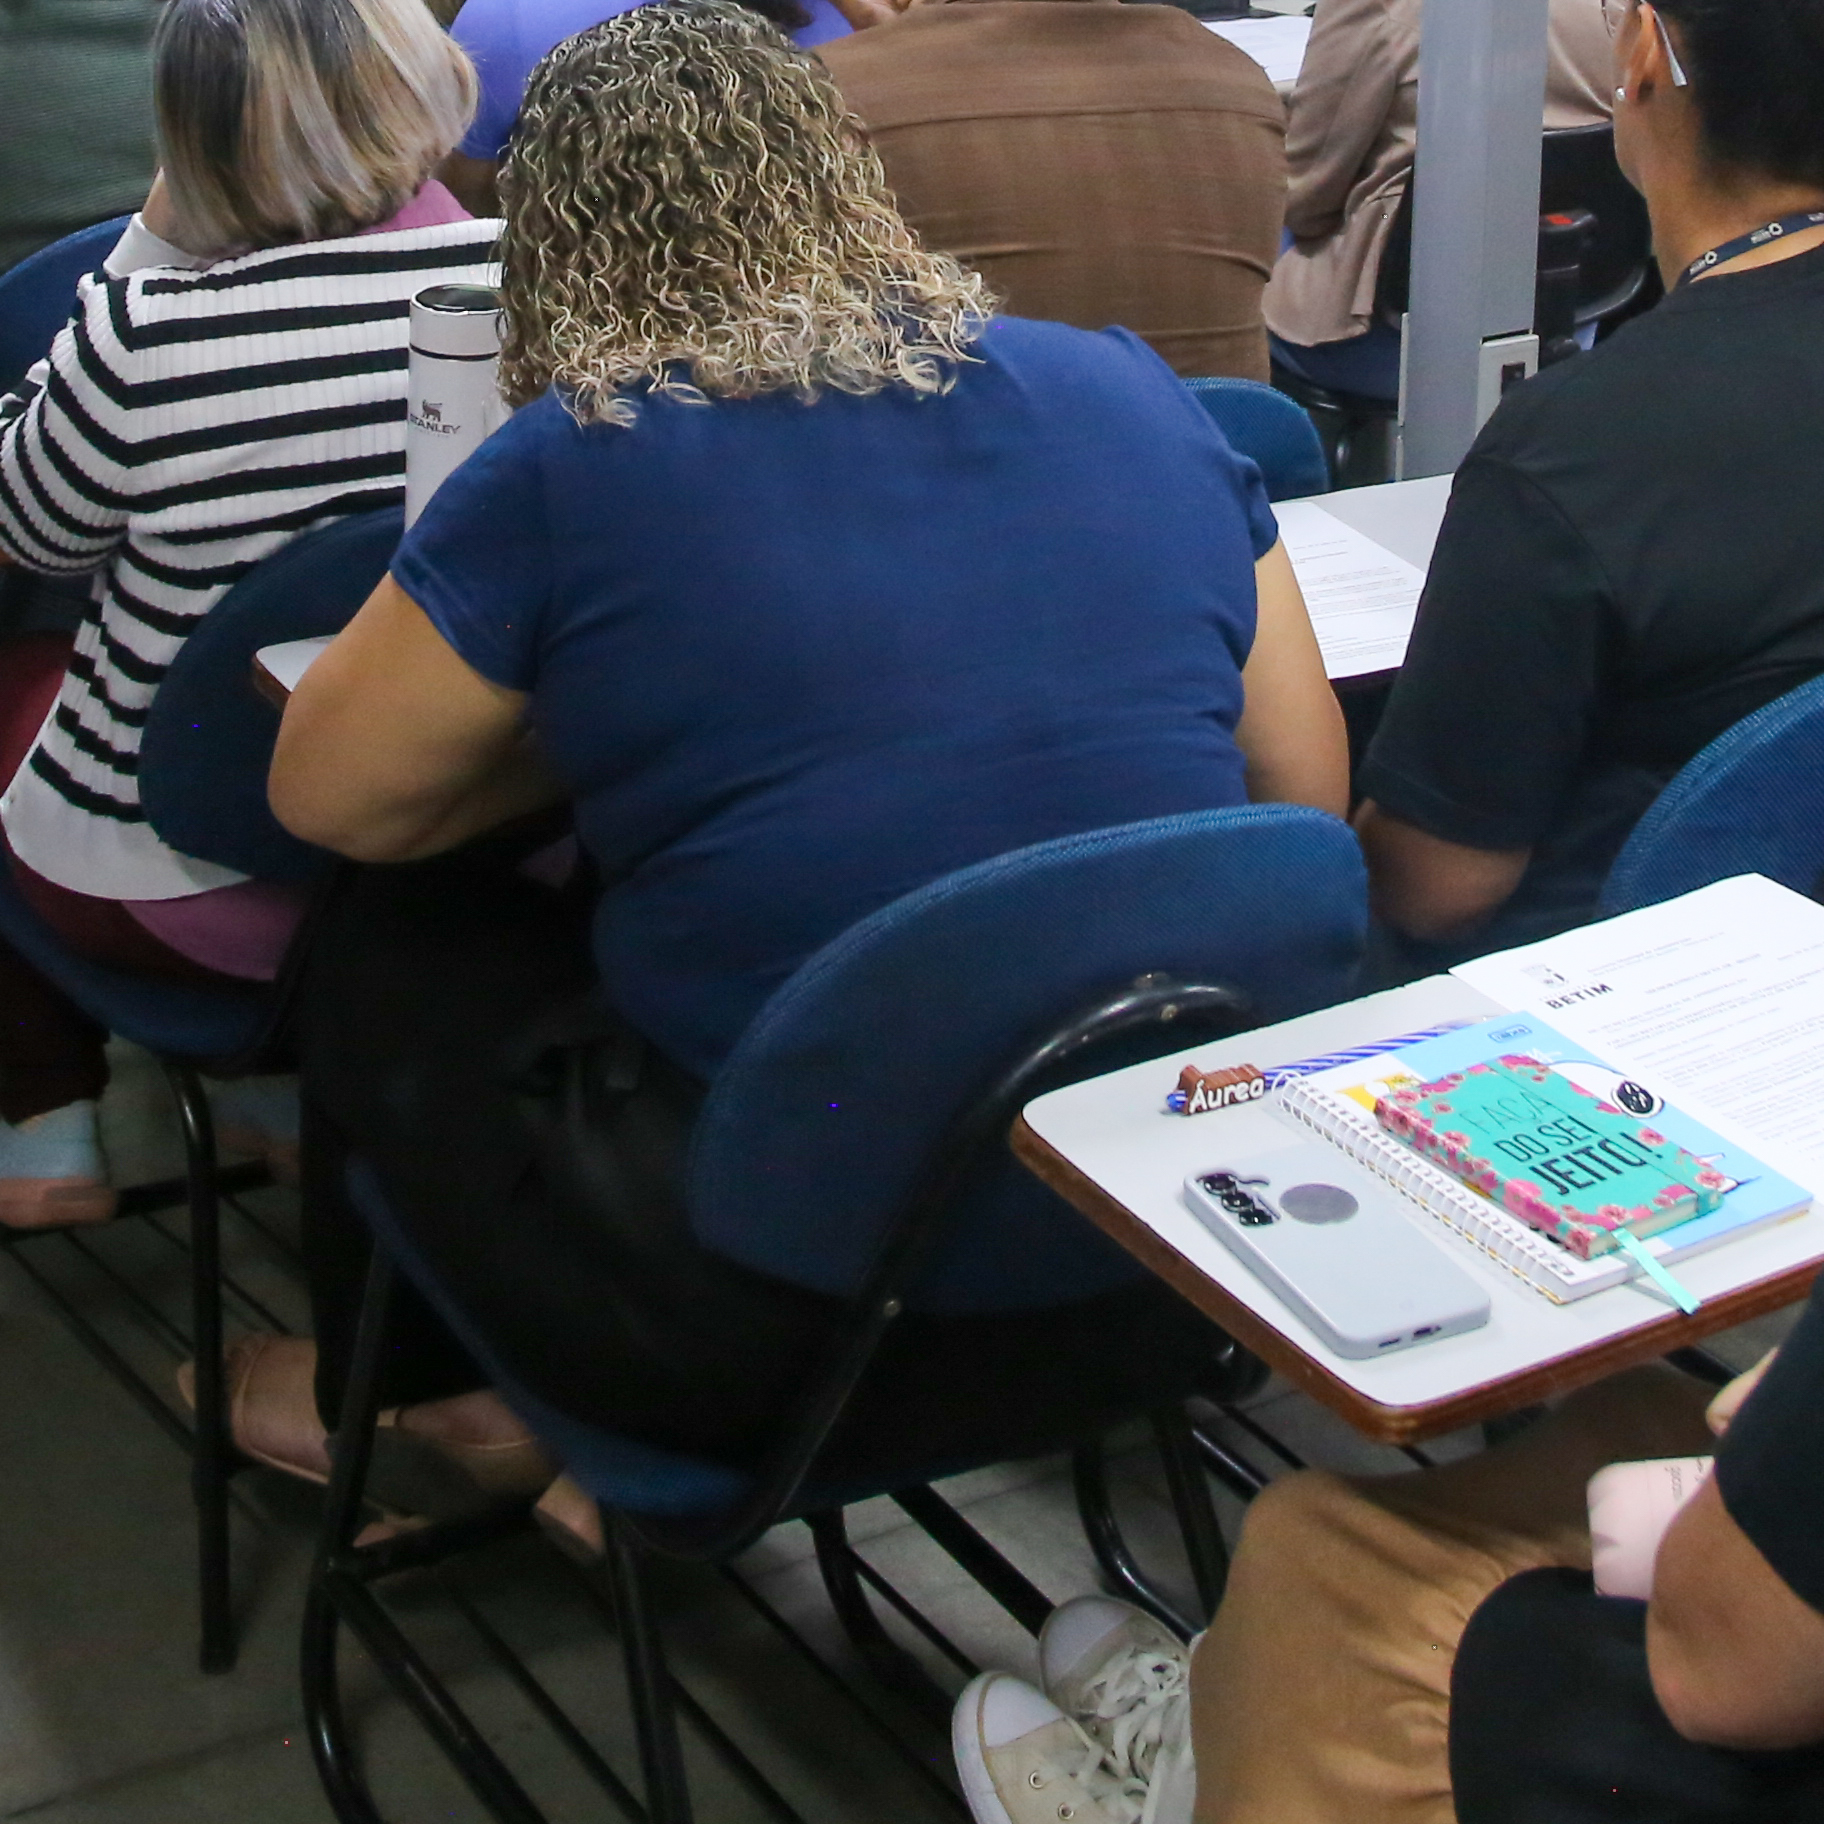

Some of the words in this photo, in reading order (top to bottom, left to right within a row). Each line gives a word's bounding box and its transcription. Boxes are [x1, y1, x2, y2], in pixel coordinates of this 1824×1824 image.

[1546, 983, 1614, 1009] BETIM
[1189, 1078, 1266, 1114] Áurea
[1494, 1133, 1550, 1162] DO
